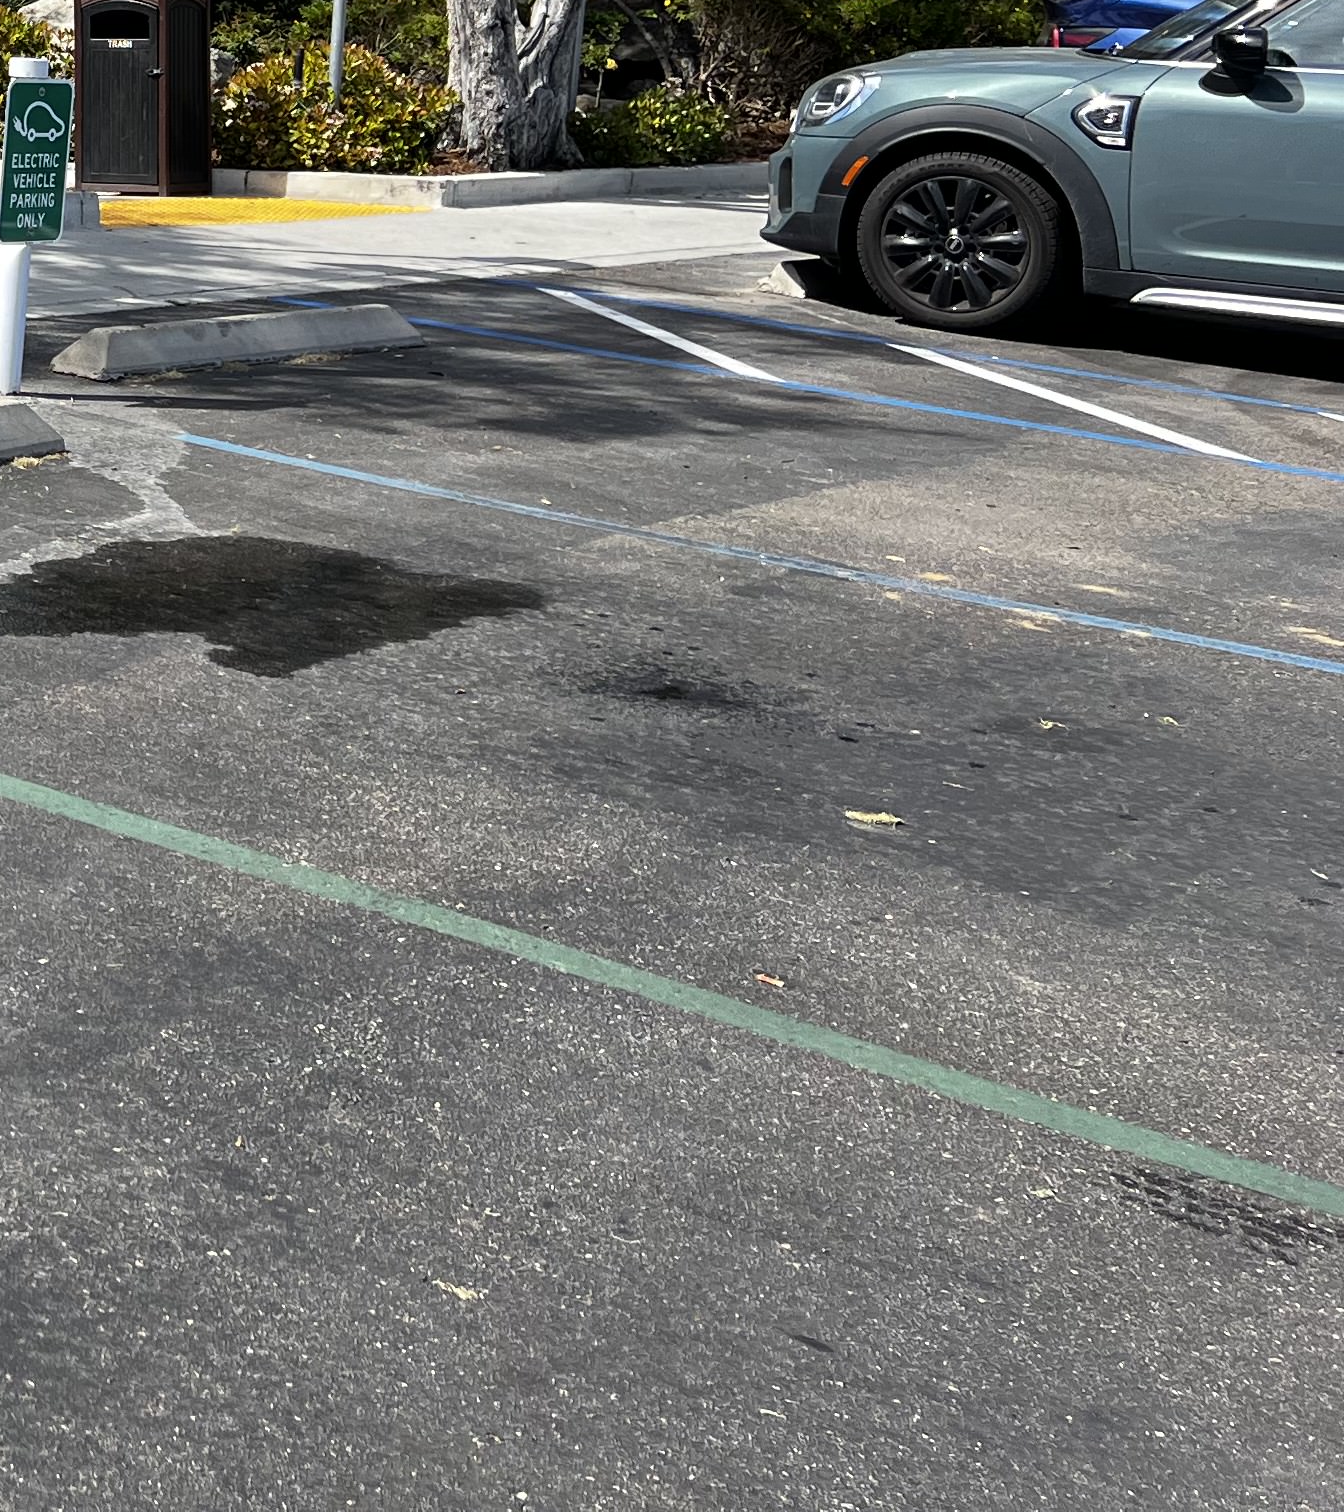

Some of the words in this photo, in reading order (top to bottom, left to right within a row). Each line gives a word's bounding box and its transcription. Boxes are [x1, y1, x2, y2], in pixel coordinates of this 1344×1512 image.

[108, 39, 132, 48] TRASH
[12, 153, 60, 168] ELECTRIC
[13, 173, 56, 188] VEHICLE
[10, 193, 55, 208] PARKING
[16, 213, 46, 228] ONLY
